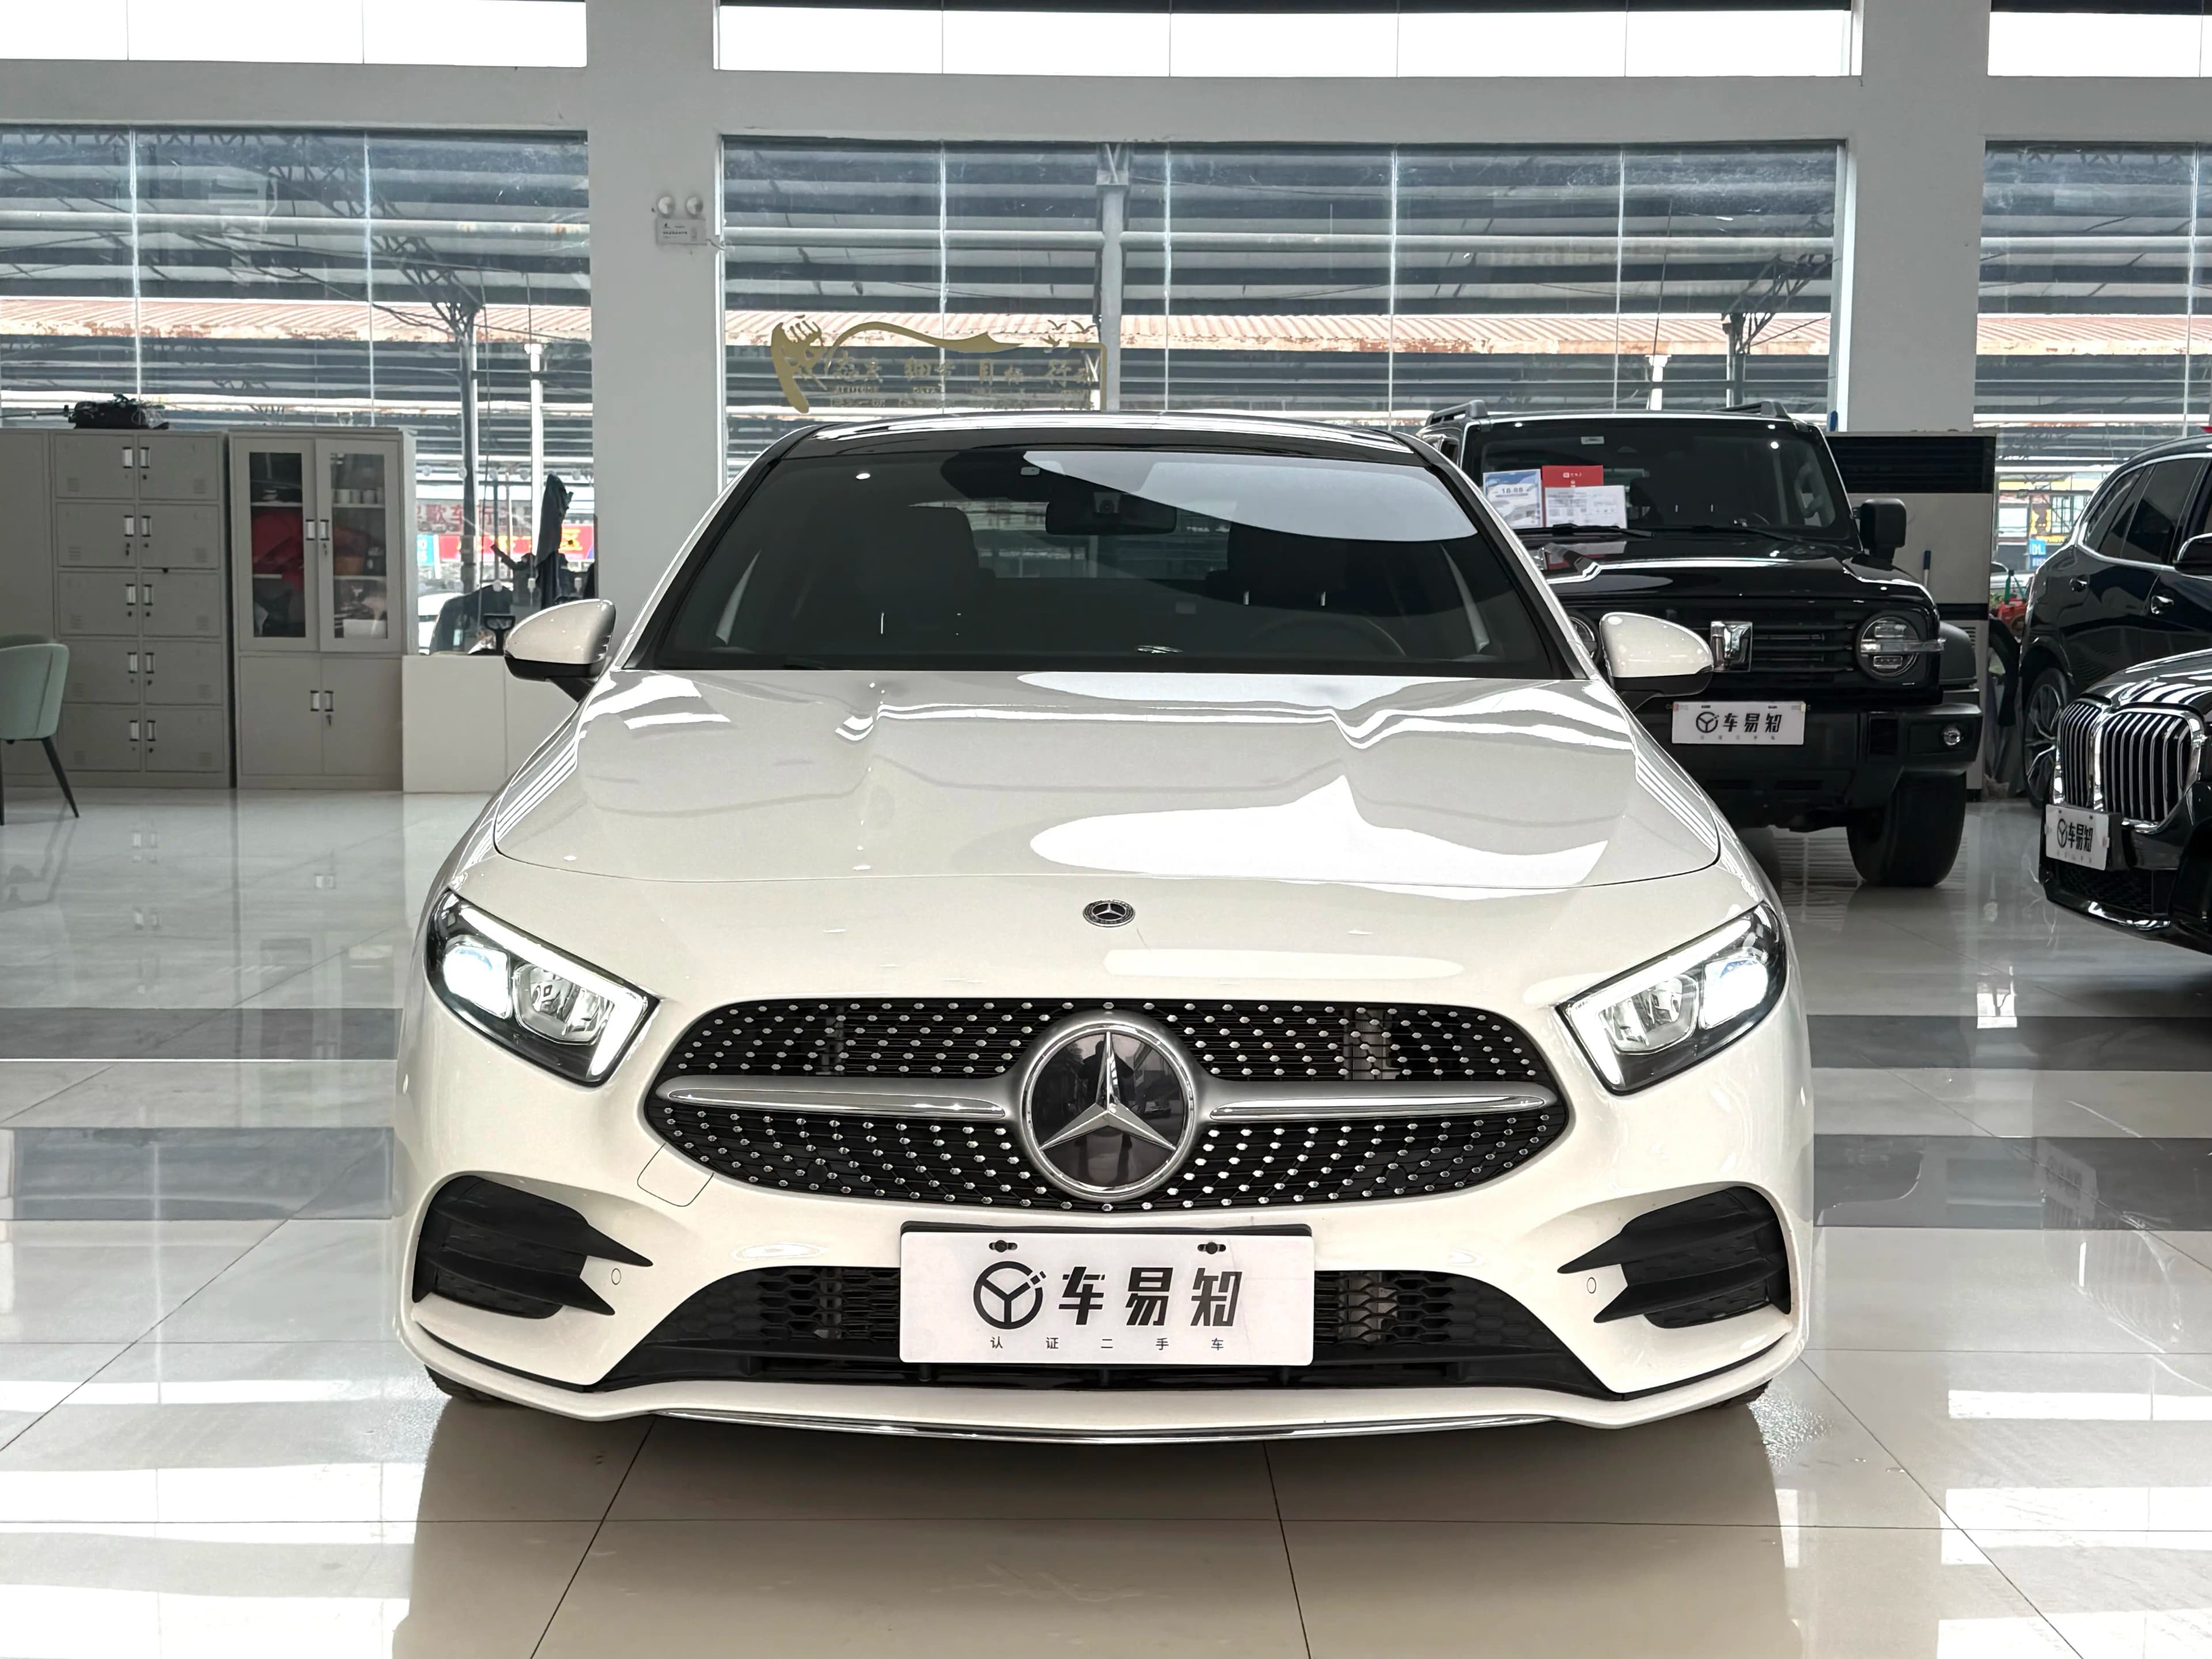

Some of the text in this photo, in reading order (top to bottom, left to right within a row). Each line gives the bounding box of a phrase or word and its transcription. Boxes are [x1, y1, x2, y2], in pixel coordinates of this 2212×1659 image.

[1722, 713, 1782, 733] 车易知
[2067, 821, 2093, 852] 车易知
[1058, 1266, 1243, 1327] 车易知
[990, 1336, 1225, 1351] 认证二手车
